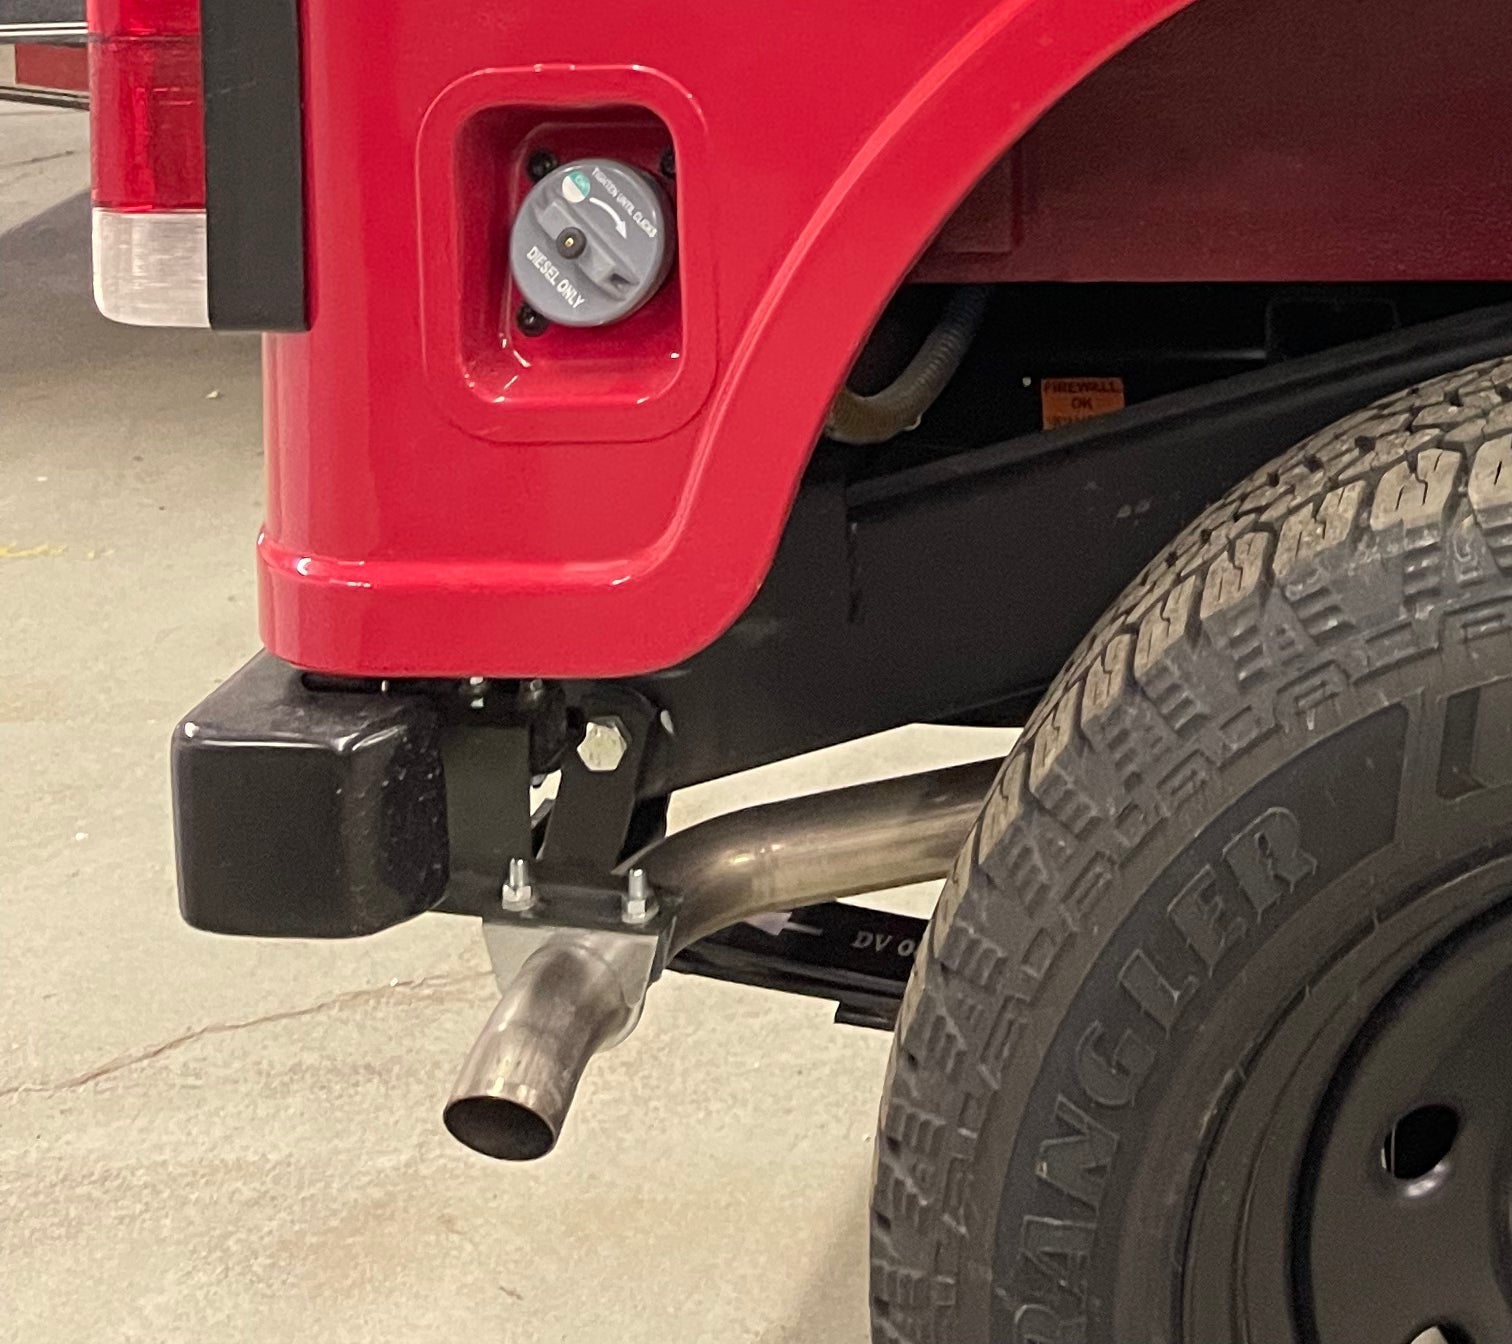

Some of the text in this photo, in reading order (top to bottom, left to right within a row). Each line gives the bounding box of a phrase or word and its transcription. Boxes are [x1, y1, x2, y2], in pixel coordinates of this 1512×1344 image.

[526, 246, 585, 309] DIESEL ONLY
[1071, 396, 1093, 410] OK
[851, 930, 892, 953] DV
